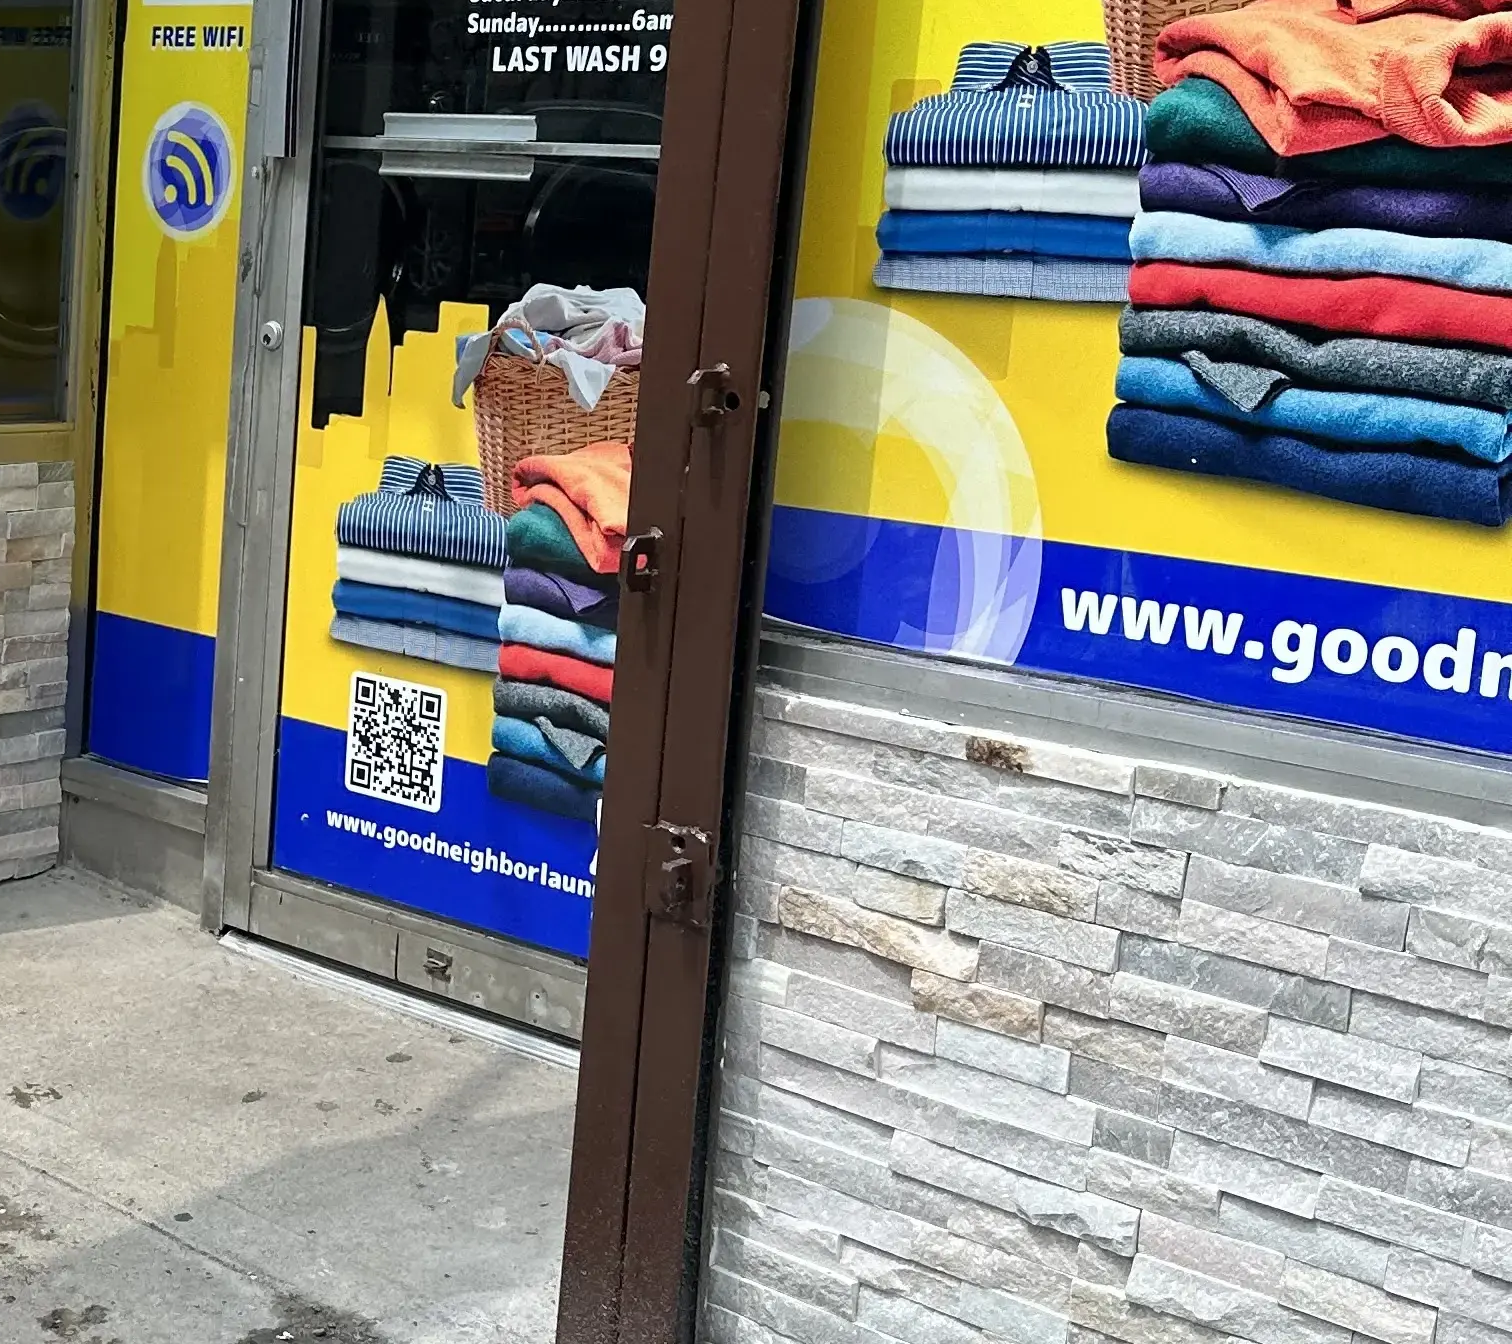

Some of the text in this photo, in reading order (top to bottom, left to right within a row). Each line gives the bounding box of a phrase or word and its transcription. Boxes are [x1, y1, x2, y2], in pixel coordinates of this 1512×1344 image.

[151, 23, 244, 49] FREE WIFI
[492, 44, 668, 73] LAST WASH 9
[1059, 585, 1512, 700] www.goodn
[326, 808, 595, 899] www.goodneighborlaun
